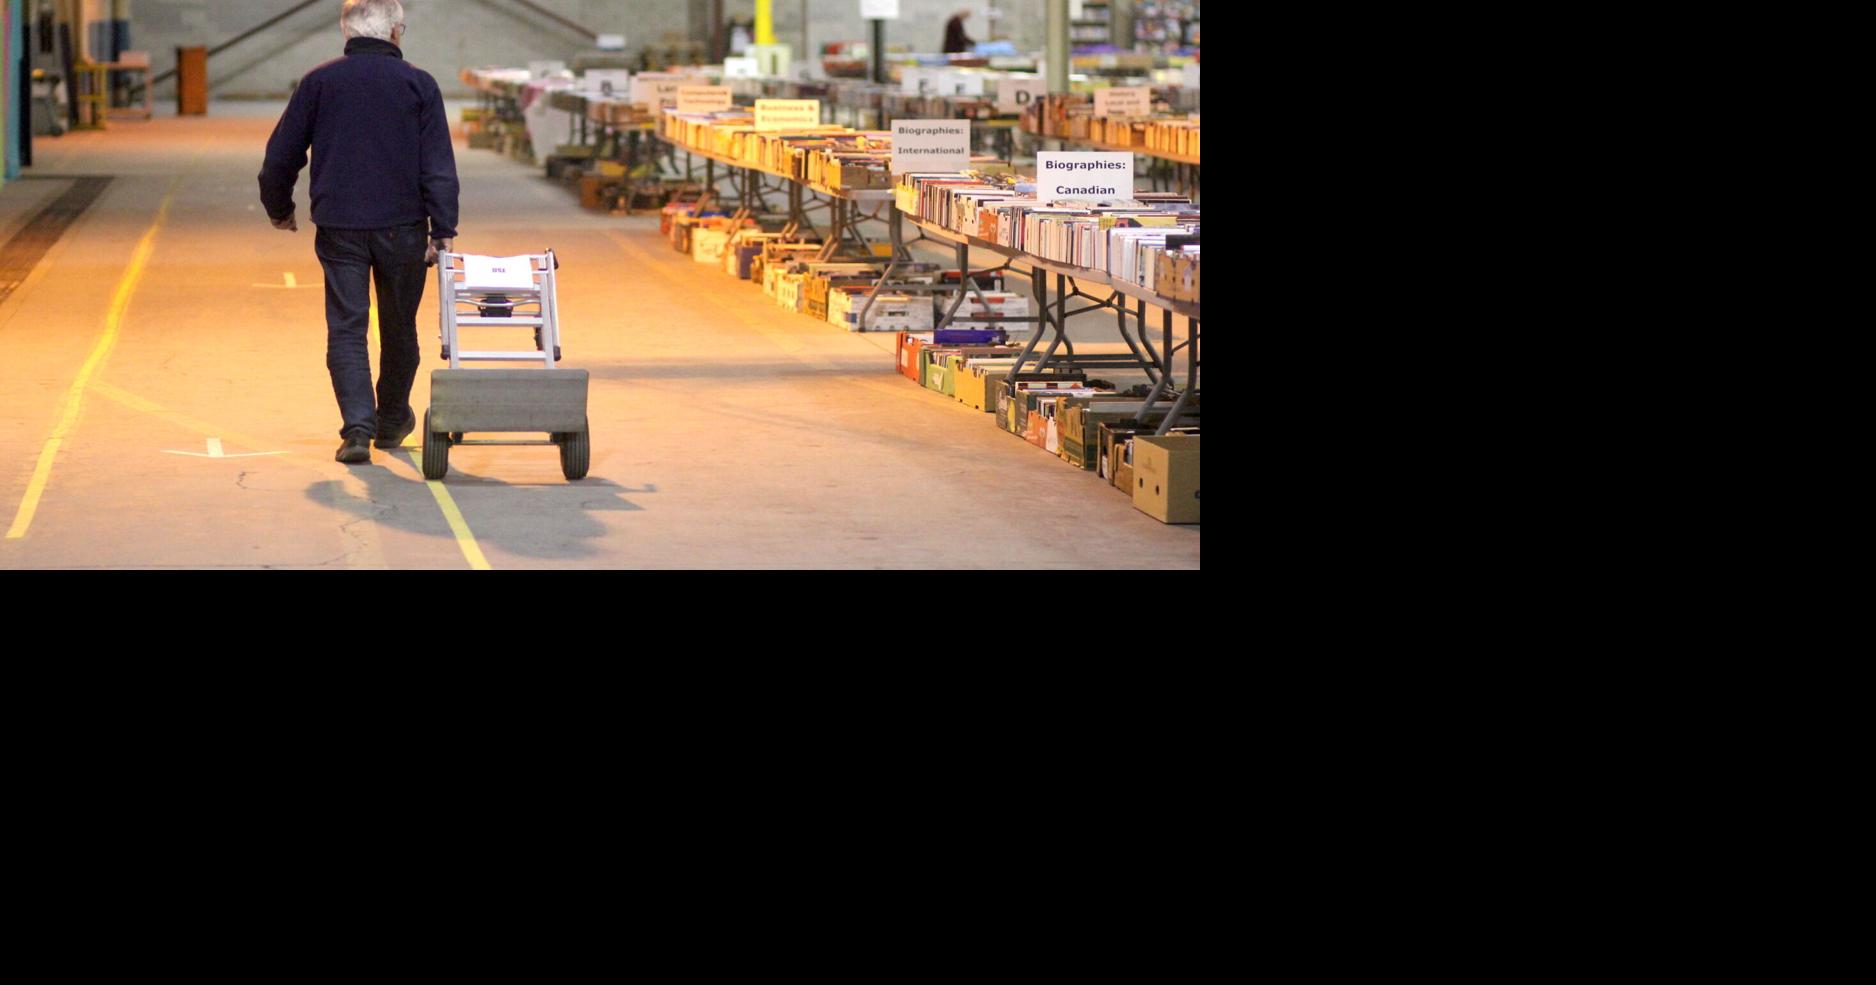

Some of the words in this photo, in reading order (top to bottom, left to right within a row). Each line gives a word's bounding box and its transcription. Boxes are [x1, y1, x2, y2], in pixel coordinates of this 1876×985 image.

[760, 103, 804, 112] Business
[761, 115, 813, 123] Economics
[898, 127, 964, 137] Biographies:
[898, 147, 965, 155] International
[1045, 160, 1127, 172] Biographies:
[1056, 185, 1116, 196] Canadian
